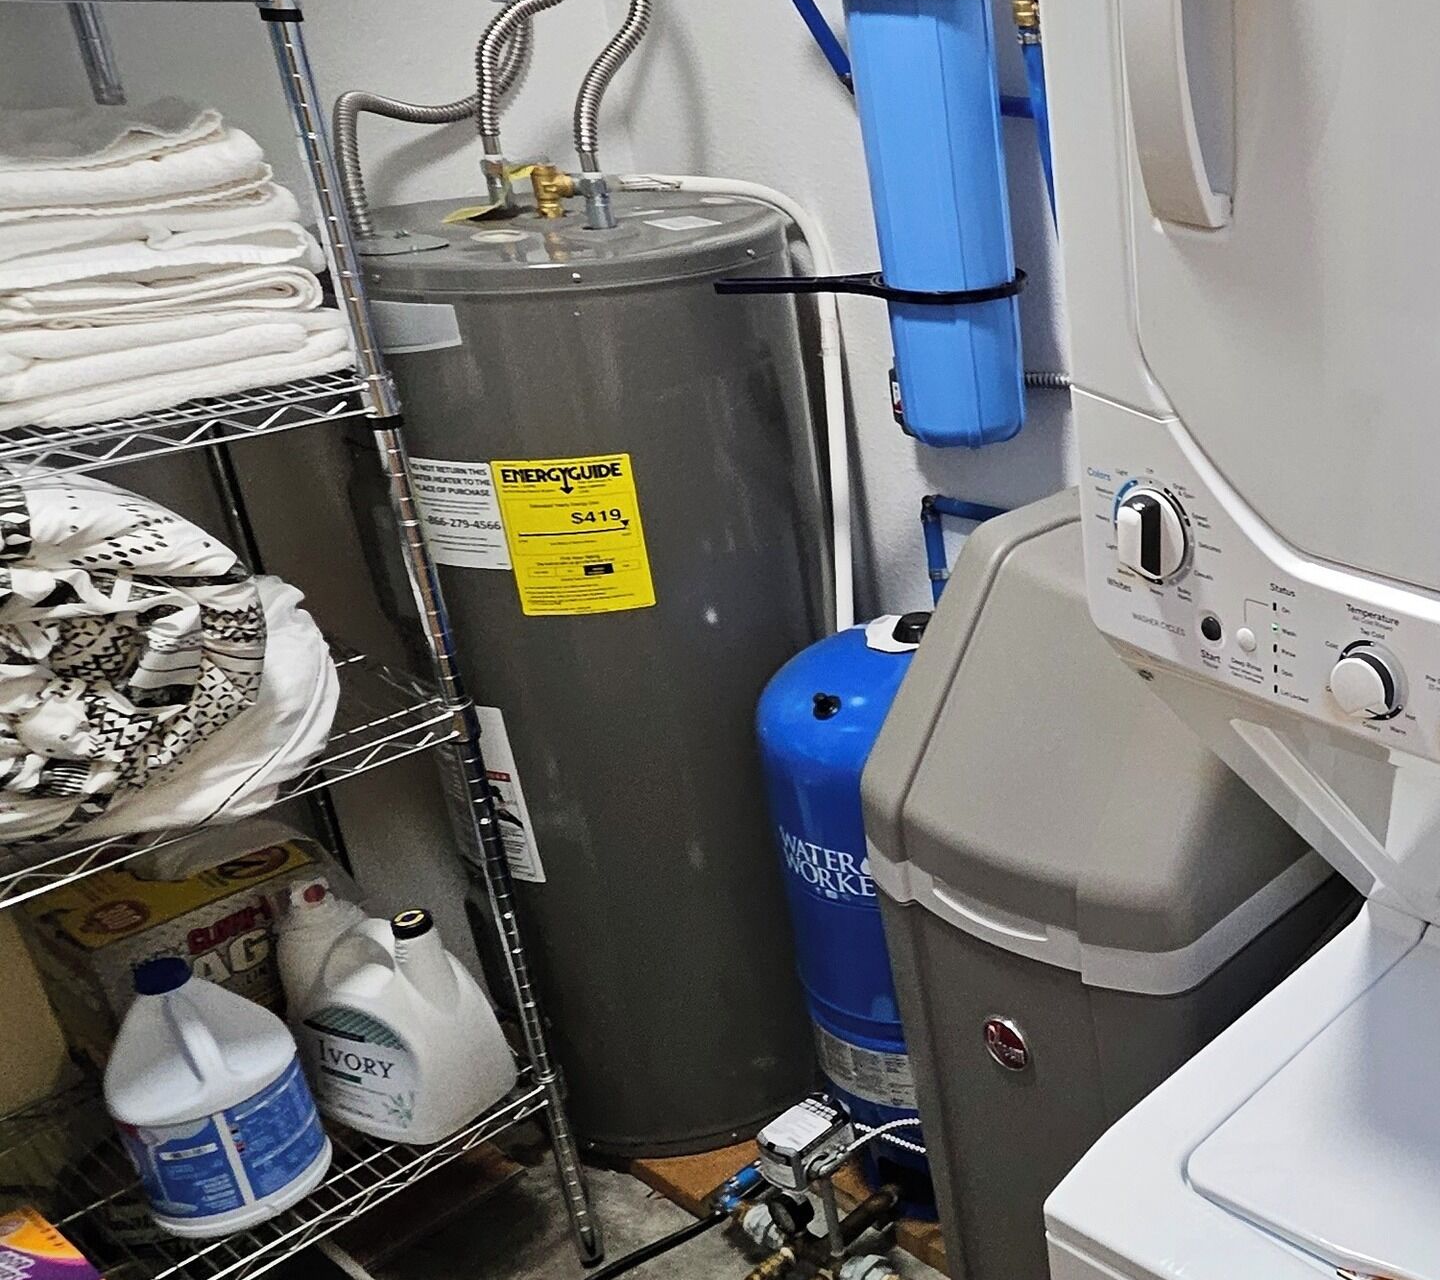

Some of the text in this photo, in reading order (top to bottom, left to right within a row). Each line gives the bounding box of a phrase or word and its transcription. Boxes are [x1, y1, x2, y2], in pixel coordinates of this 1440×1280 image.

[436, 466, 467, 474] RETURN
[468, 468, 487, 476] THIS
[1087, 467, 1112, 482] Colors
[448, 487, 491, 497] PURCHASE
[1269, 583, 1296, 598] Status
[1346, 603, 1400, 626] Temperature
[1371, 631, 1385, 640] Cold
[1200, 649, 1221, 664] Start
[779, 825, 861, 875] WATER
[783, 846, 877, 897] WORKE
[320, 1039, 395, 1079] IVORY
